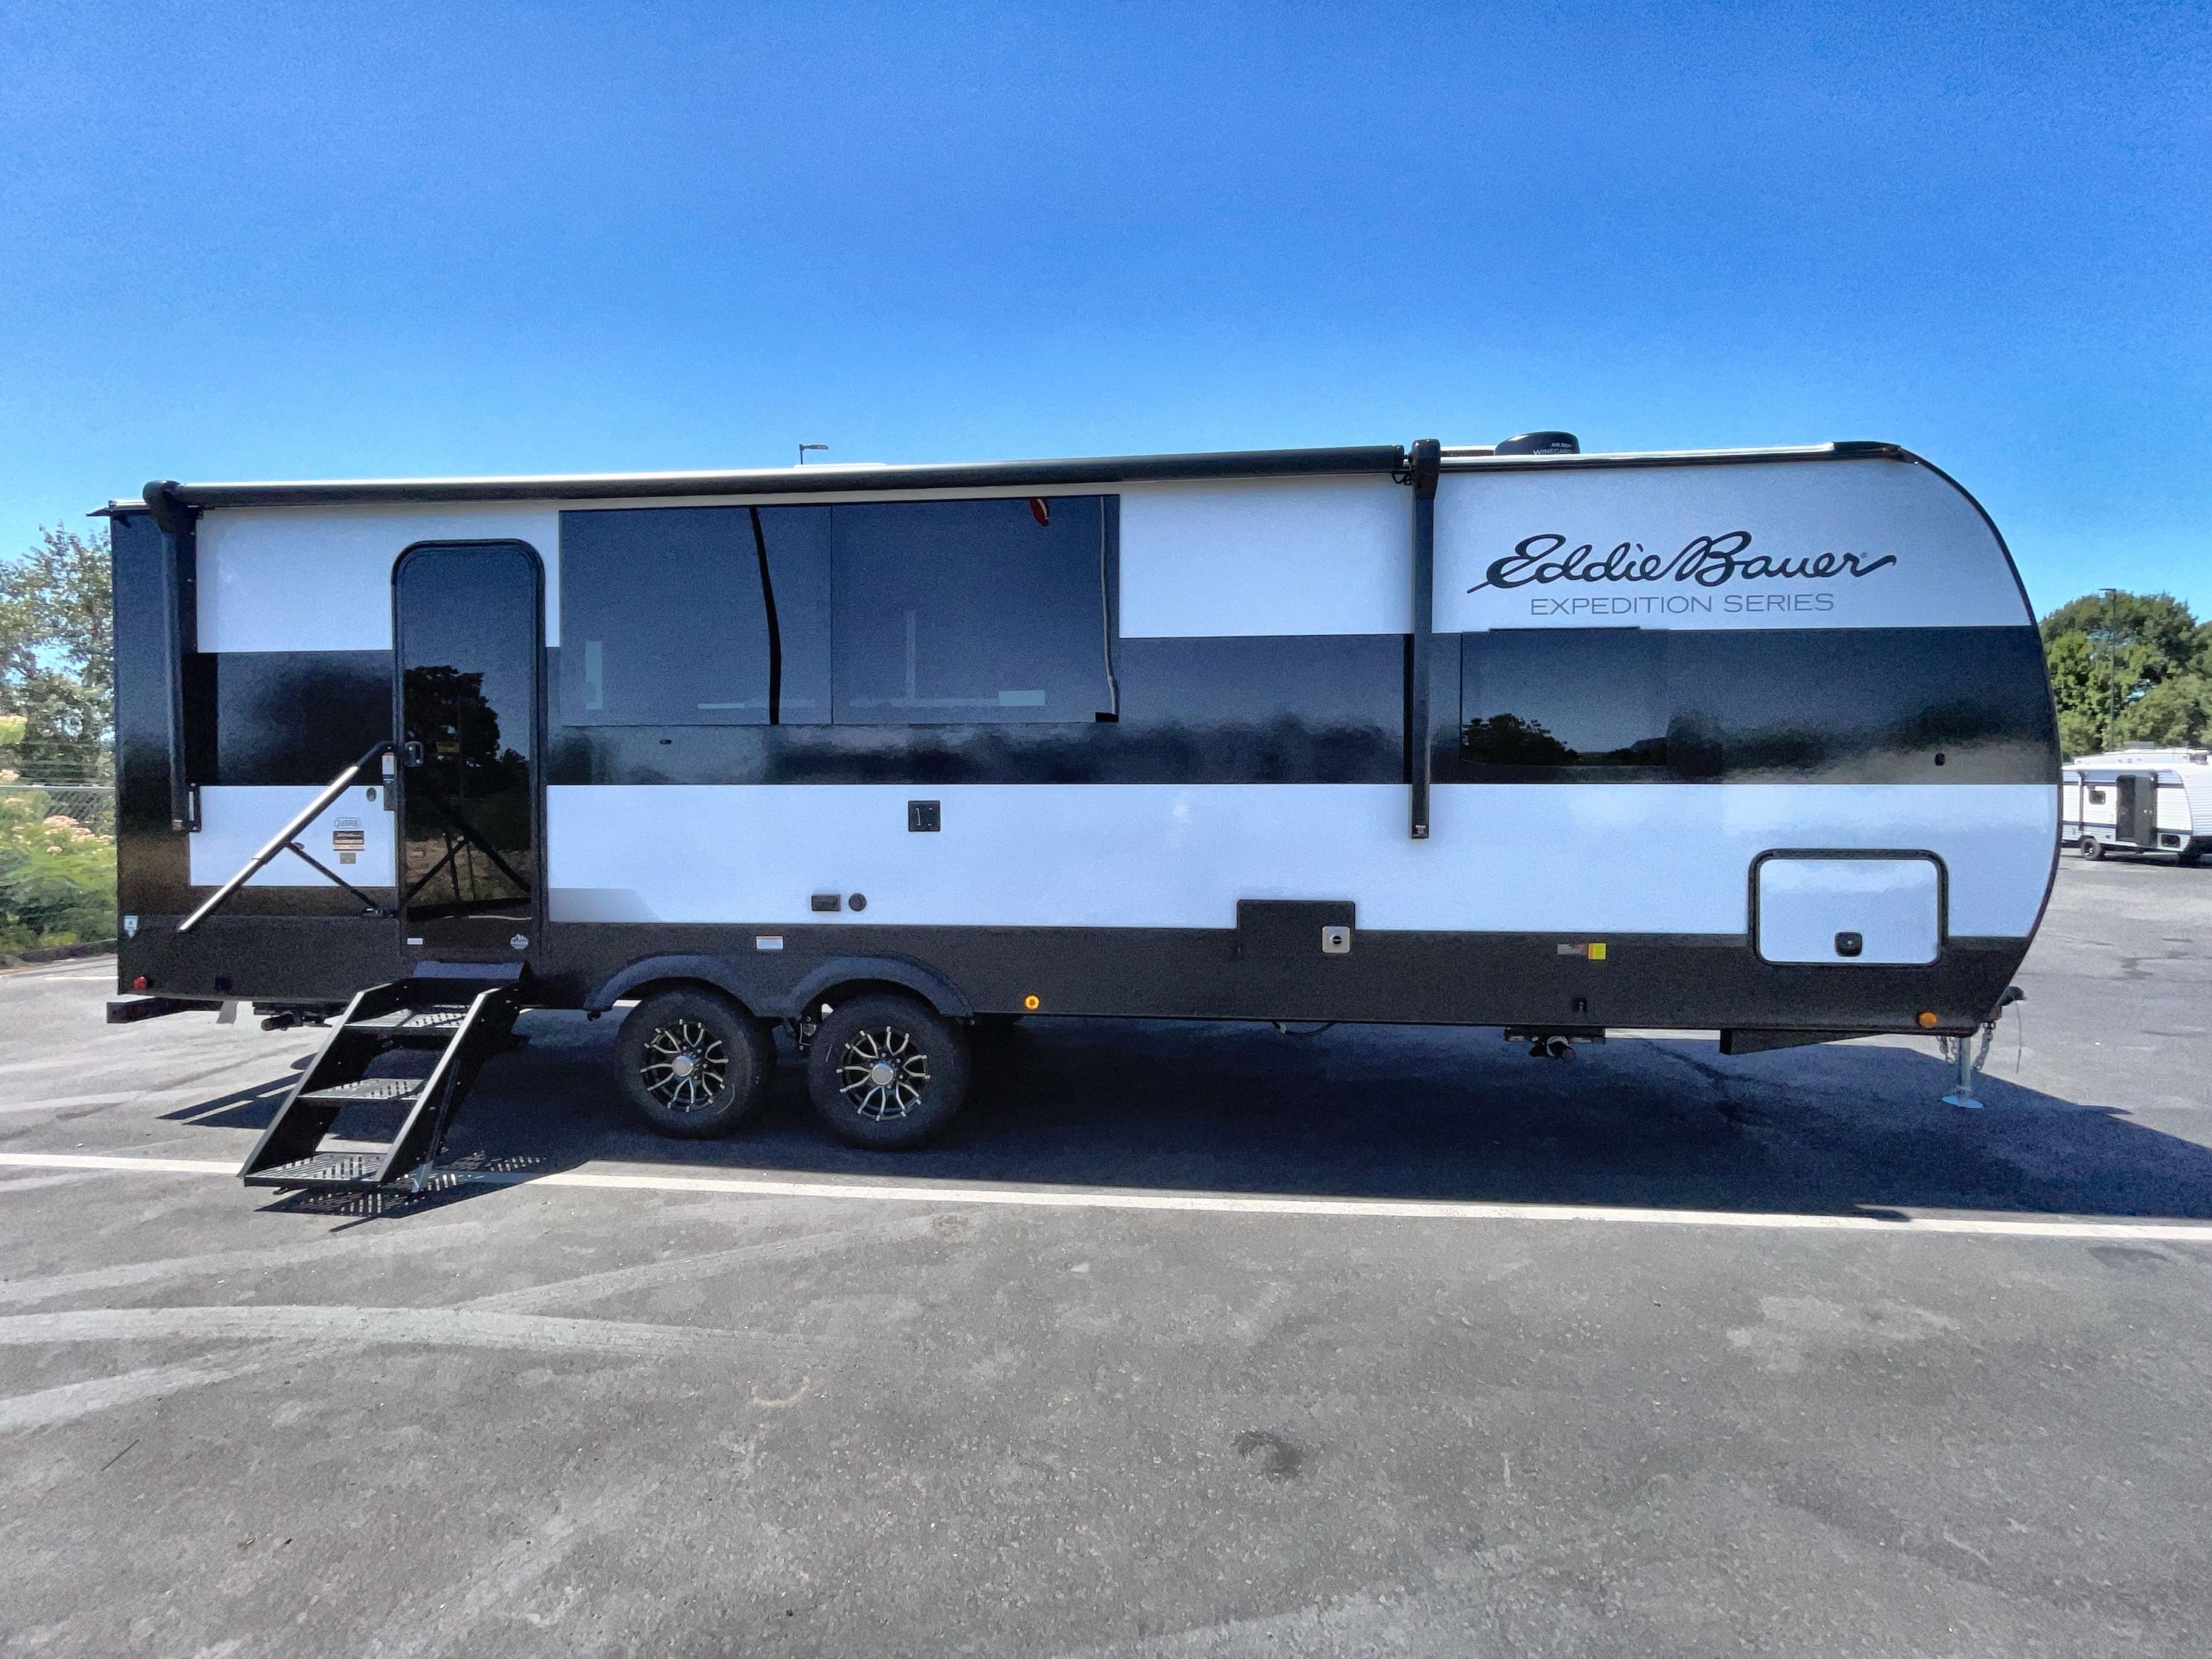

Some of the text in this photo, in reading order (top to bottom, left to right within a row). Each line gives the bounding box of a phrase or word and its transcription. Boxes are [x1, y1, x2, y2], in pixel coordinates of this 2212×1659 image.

[1467, 530, 1897, 594] Eddie Bauer
[1530, 593, 1834, 616] EXPEDITION SERIES
